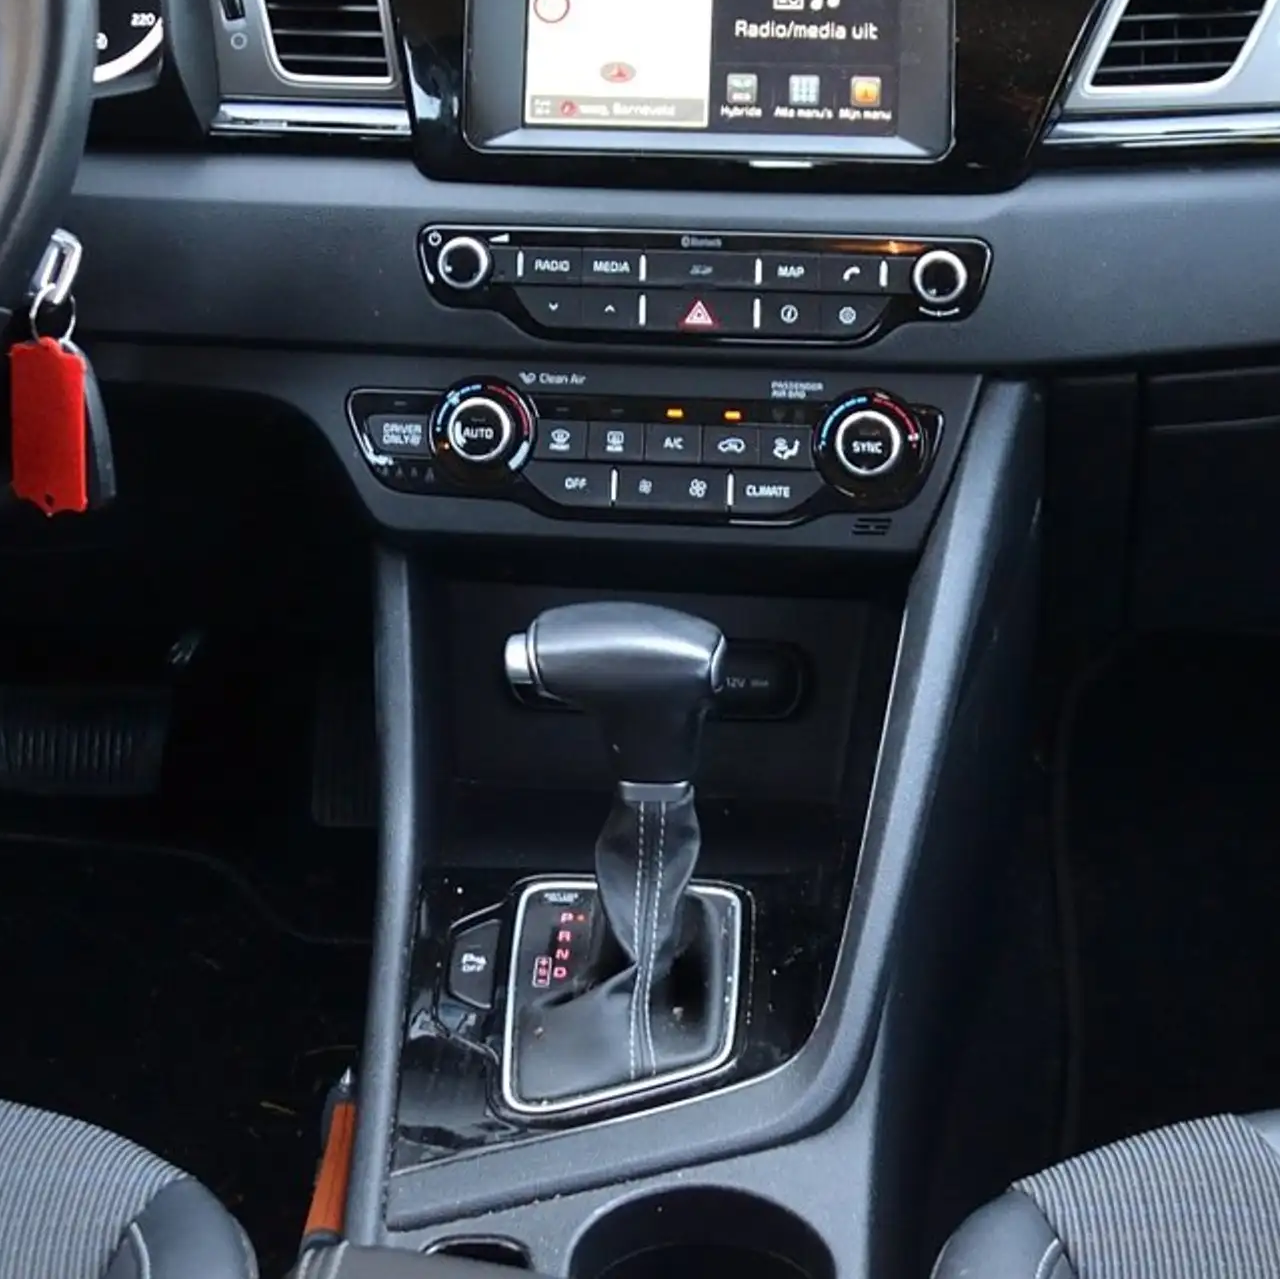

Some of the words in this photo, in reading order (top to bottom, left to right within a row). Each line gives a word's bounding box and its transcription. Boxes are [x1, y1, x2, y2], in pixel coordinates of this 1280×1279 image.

[130, 12, 156, 27] 220
[734, 19, 847, 39] Radio/media
[851, 21, 878, 40] uit
[534, 258, 571, 272] RADIO
[592, 260, 631, 273] MEDIA
[777, 264, 805, 278] MAP
[539, 372, 568, 385] Clean
[570, 373, 587, 385] Air
[463, 426, 494, 439] AUTO
[663, 436, 685, 450] A/C
[852, 440, 883, 454] SYNC
[564, 476, 588, 490] OFF
[745, 484, 791, 498] CLIMATE
[560, 912, 574, 924] P
[555, 948, 569, 961] N
[553, 966, 567, 979] D
